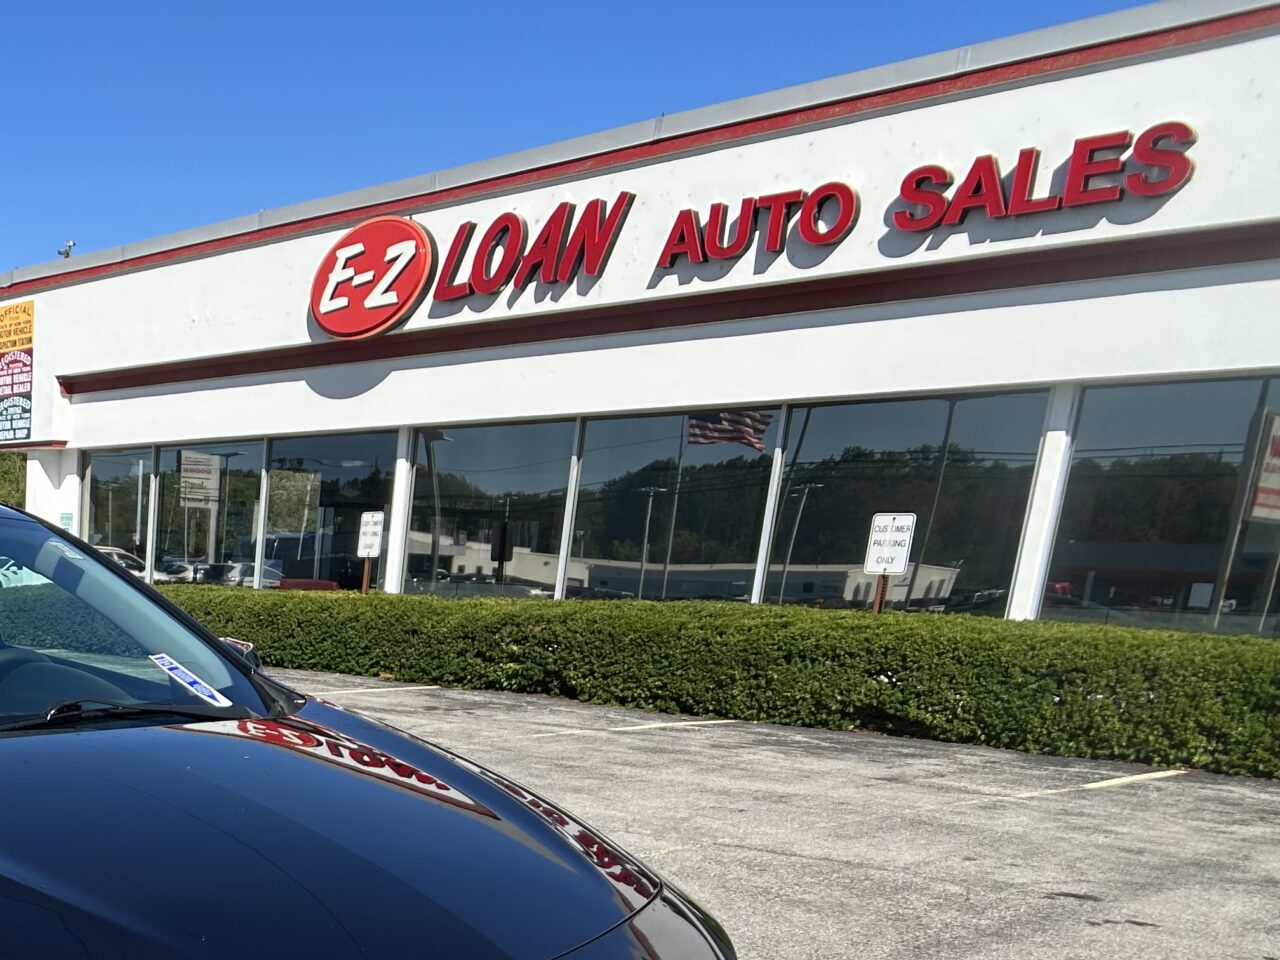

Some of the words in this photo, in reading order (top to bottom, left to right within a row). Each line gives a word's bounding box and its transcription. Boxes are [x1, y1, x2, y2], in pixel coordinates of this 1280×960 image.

[319, 240, 417, 314] E-Z
[432, 192, 636, 301] LOAN
[657, 181, 861, 268] AUTO
[892, 121, 1197, 232] SALES
[0, 304, 32, 323] OFFICIAL
[876, 556, 895, 564] ONLY
